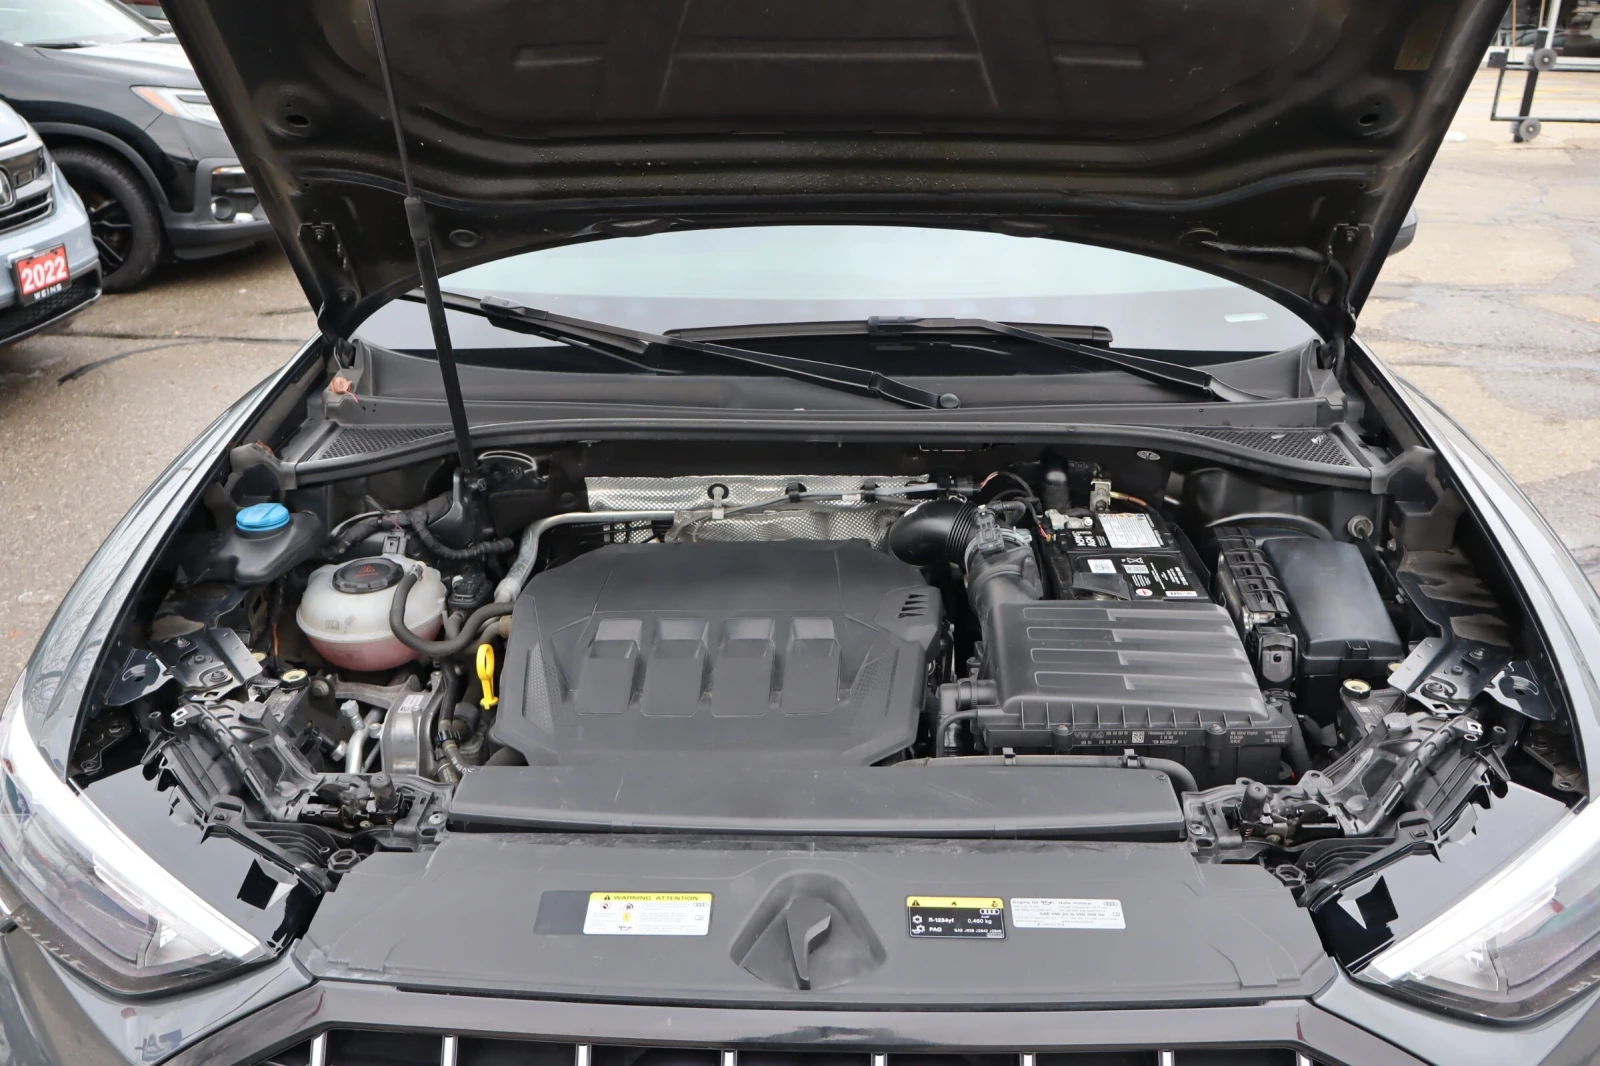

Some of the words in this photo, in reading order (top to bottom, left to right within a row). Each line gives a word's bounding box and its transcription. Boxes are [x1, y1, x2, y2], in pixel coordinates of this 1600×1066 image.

[21, 256, 67, 294] 2022
[33, 283, 63, 300] WEINS
[1074, 731, 1090, 739] VW
